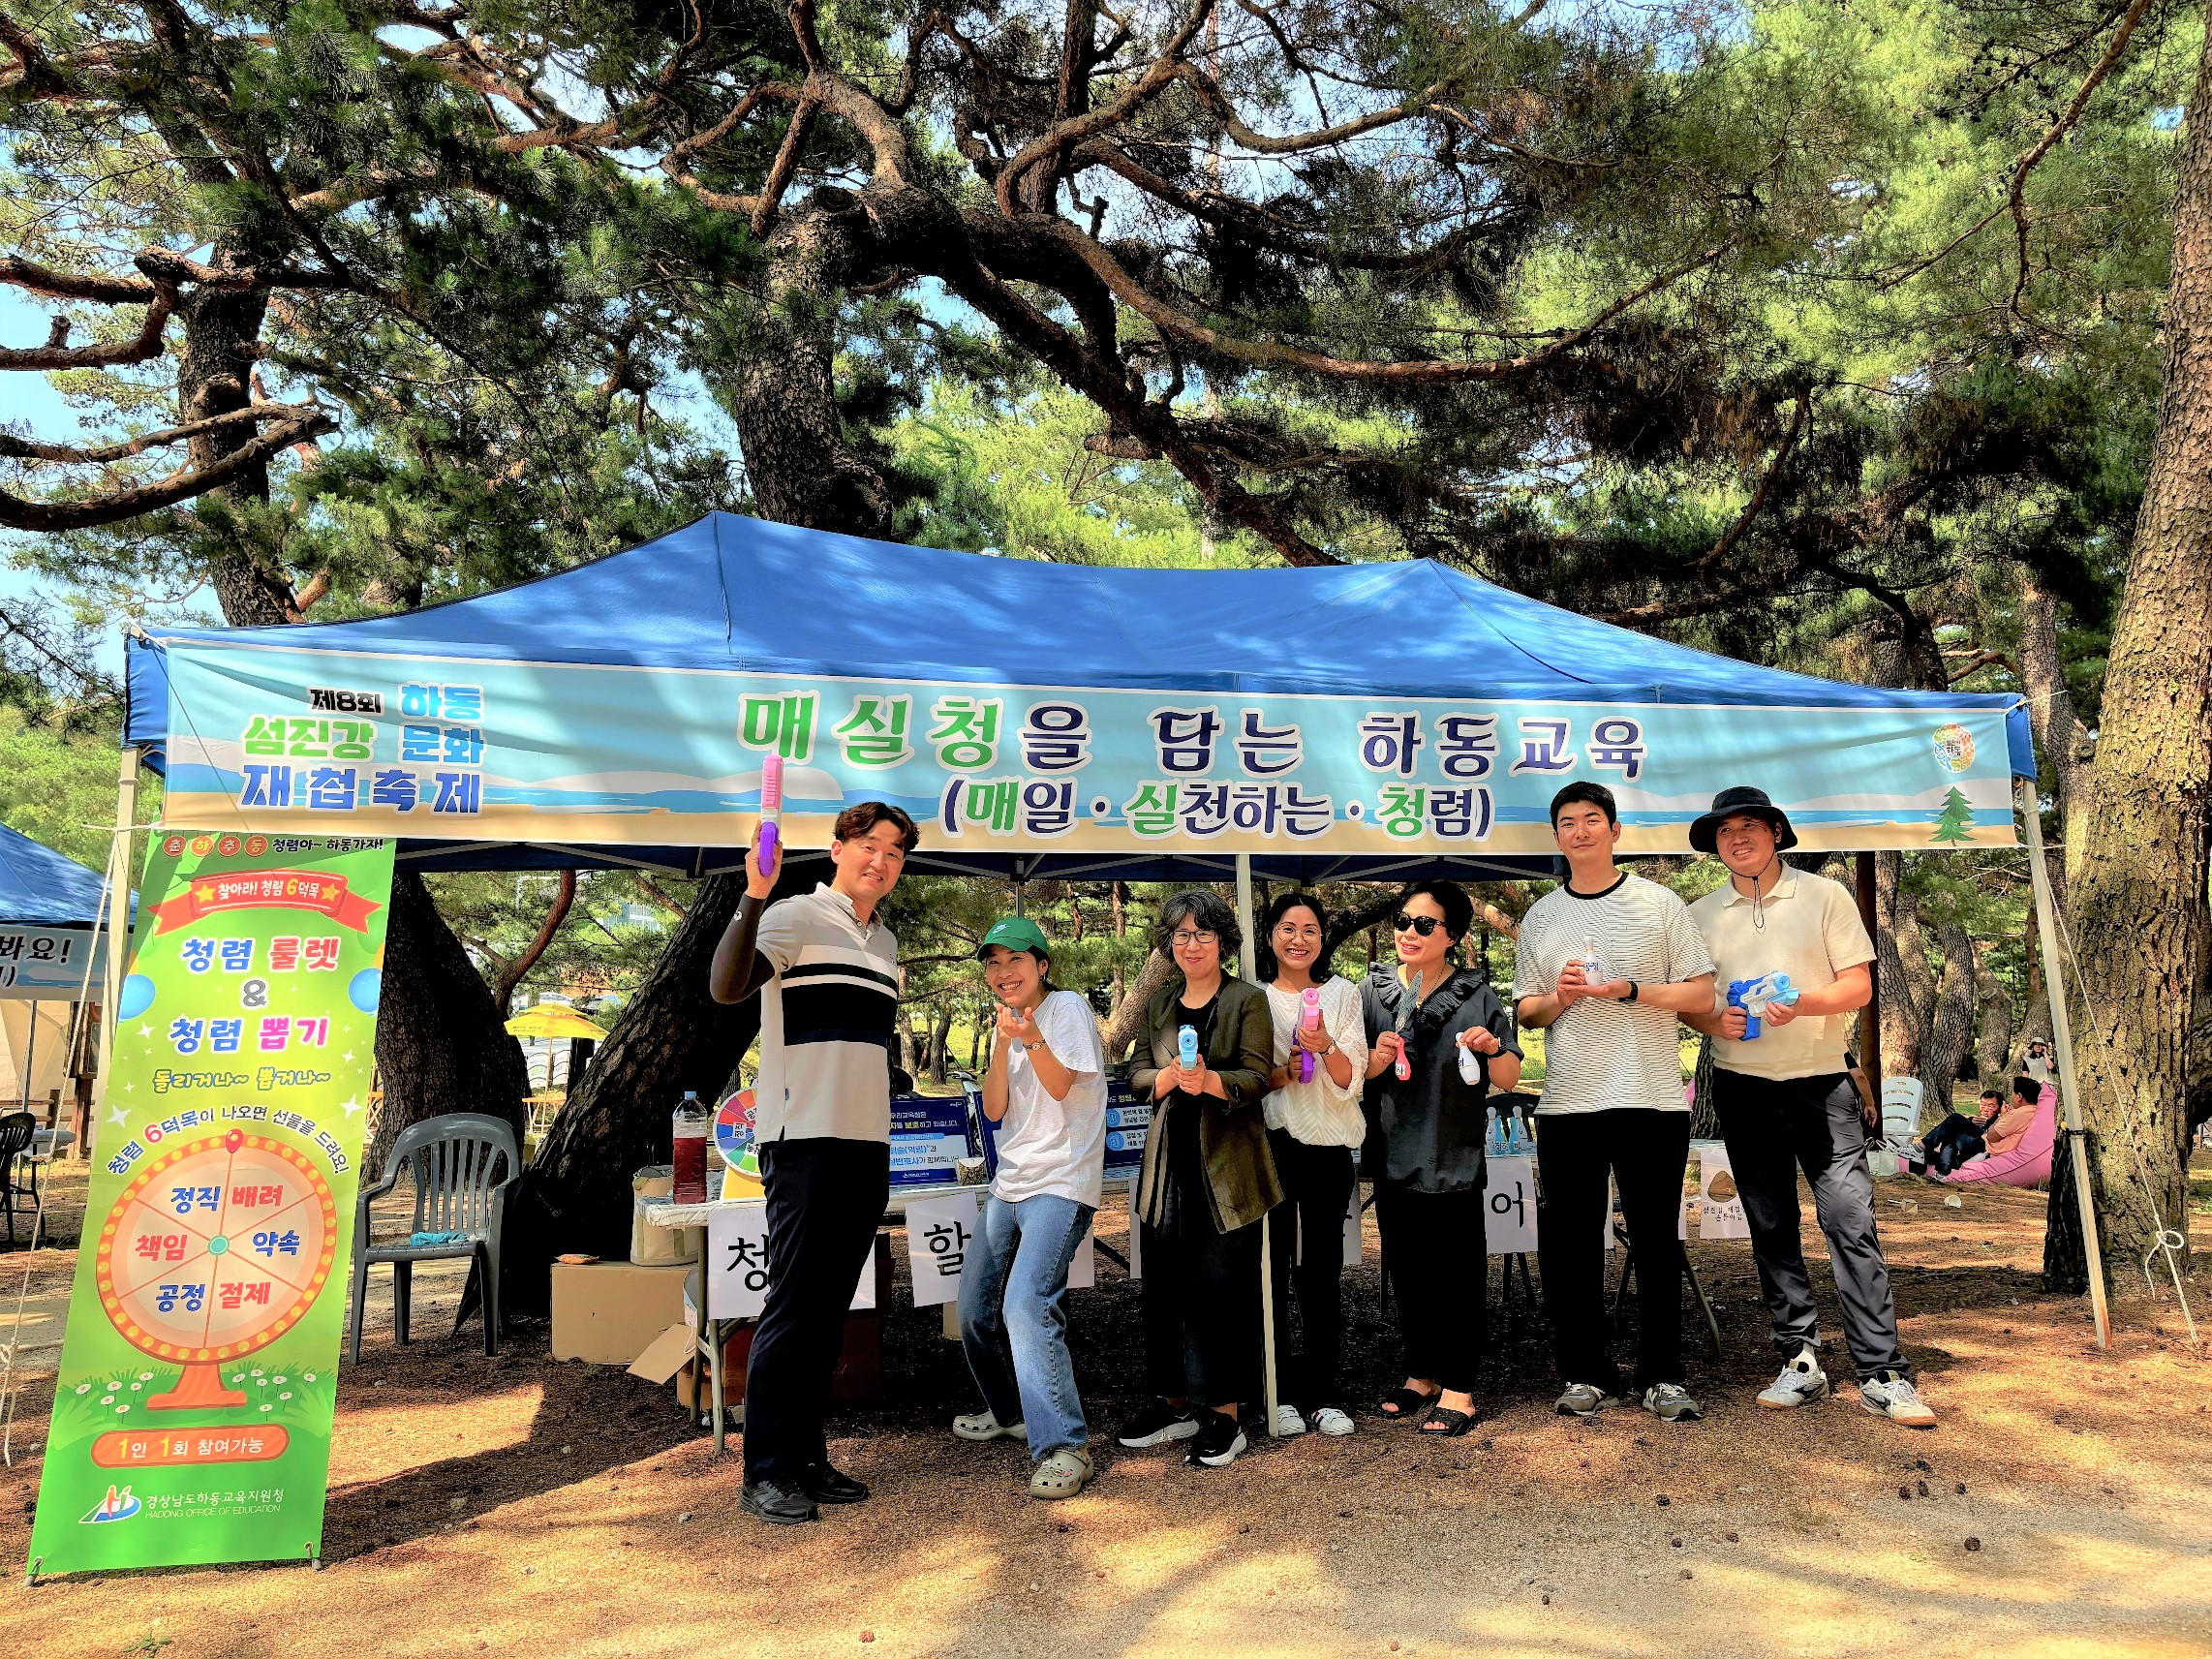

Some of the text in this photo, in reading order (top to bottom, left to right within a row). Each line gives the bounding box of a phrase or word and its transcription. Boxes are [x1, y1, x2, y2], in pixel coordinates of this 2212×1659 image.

[310, 684, 482, 720] 제8회 하동
[245, 716, 484, 763] 섬진강 문화
[744, 695, 1644, 778] 매실청을 담는 하동교육
[241, 765, 479, 814] 재첩축제
[326, 838, 384, 852] 하동가자!
[218, 877, 320, 901] 찾아라! 청렴 6덕목
[182, 937, 339, 972] 청렴 룰렛
[242, 980, 267, 1007] &
[169, 1018, 328, 1053] 청렴 뽑기
[108, 1105, 350, 1175] 청렴 6덕목이 나오면 선물을 드려요!
[170, 1184, 284, 1214] 정직 배려
[135, 1229, 301, 1262] 책임 약속
[155, 1281, 271, 1313] 공정 절제
[118, 1436, 264, 1459] 1인 1회 참여가능
[145, 1504, 281, 1520] HADONG OFFICE OF EDUCATION
[146, 1489, 285, 1510] 경상남도하동교육지원청
